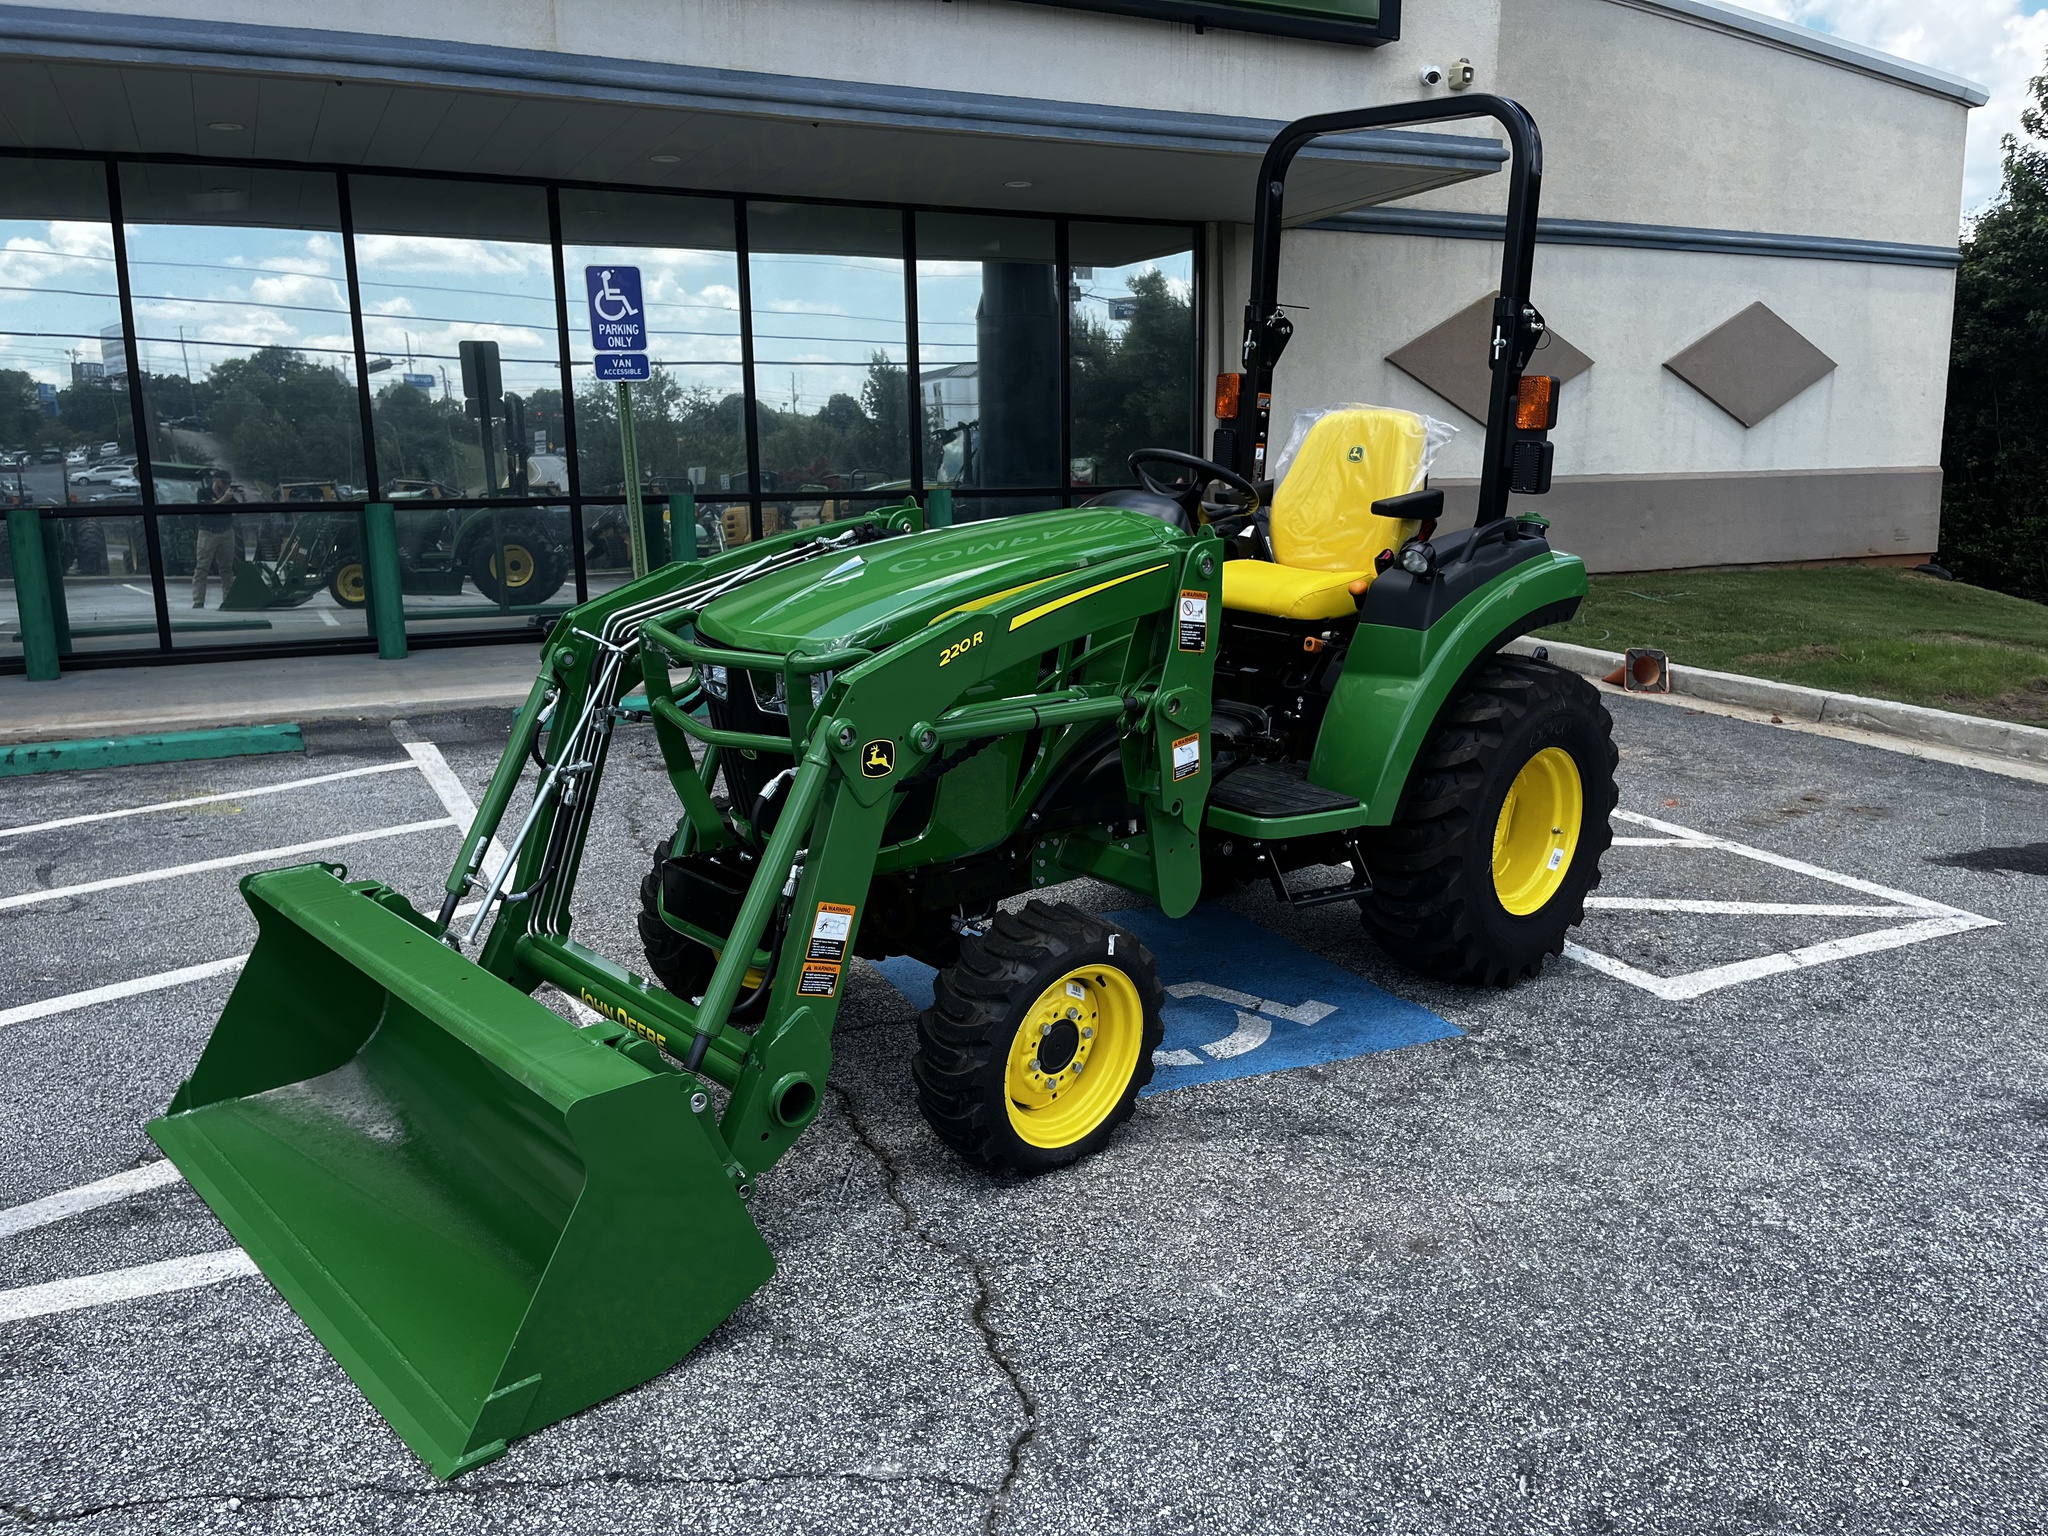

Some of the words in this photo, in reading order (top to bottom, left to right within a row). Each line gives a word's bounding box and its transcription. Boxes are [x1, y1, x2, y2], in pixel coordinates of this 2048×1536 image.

[598, 324, 639, 335] PARKING
[608, 336, 632, 347] ONLY
[612, 359, 631, 368] VAN
[939, 637, 971, 667] 220
[972, 630, 984, 647] R
[828, 906, 851, 914] WARNING
[813, 965, 837, 973] WARNING
[581, 987, 614, 1019] JOHN
[617, 1007, 668, 1052] DEERE
